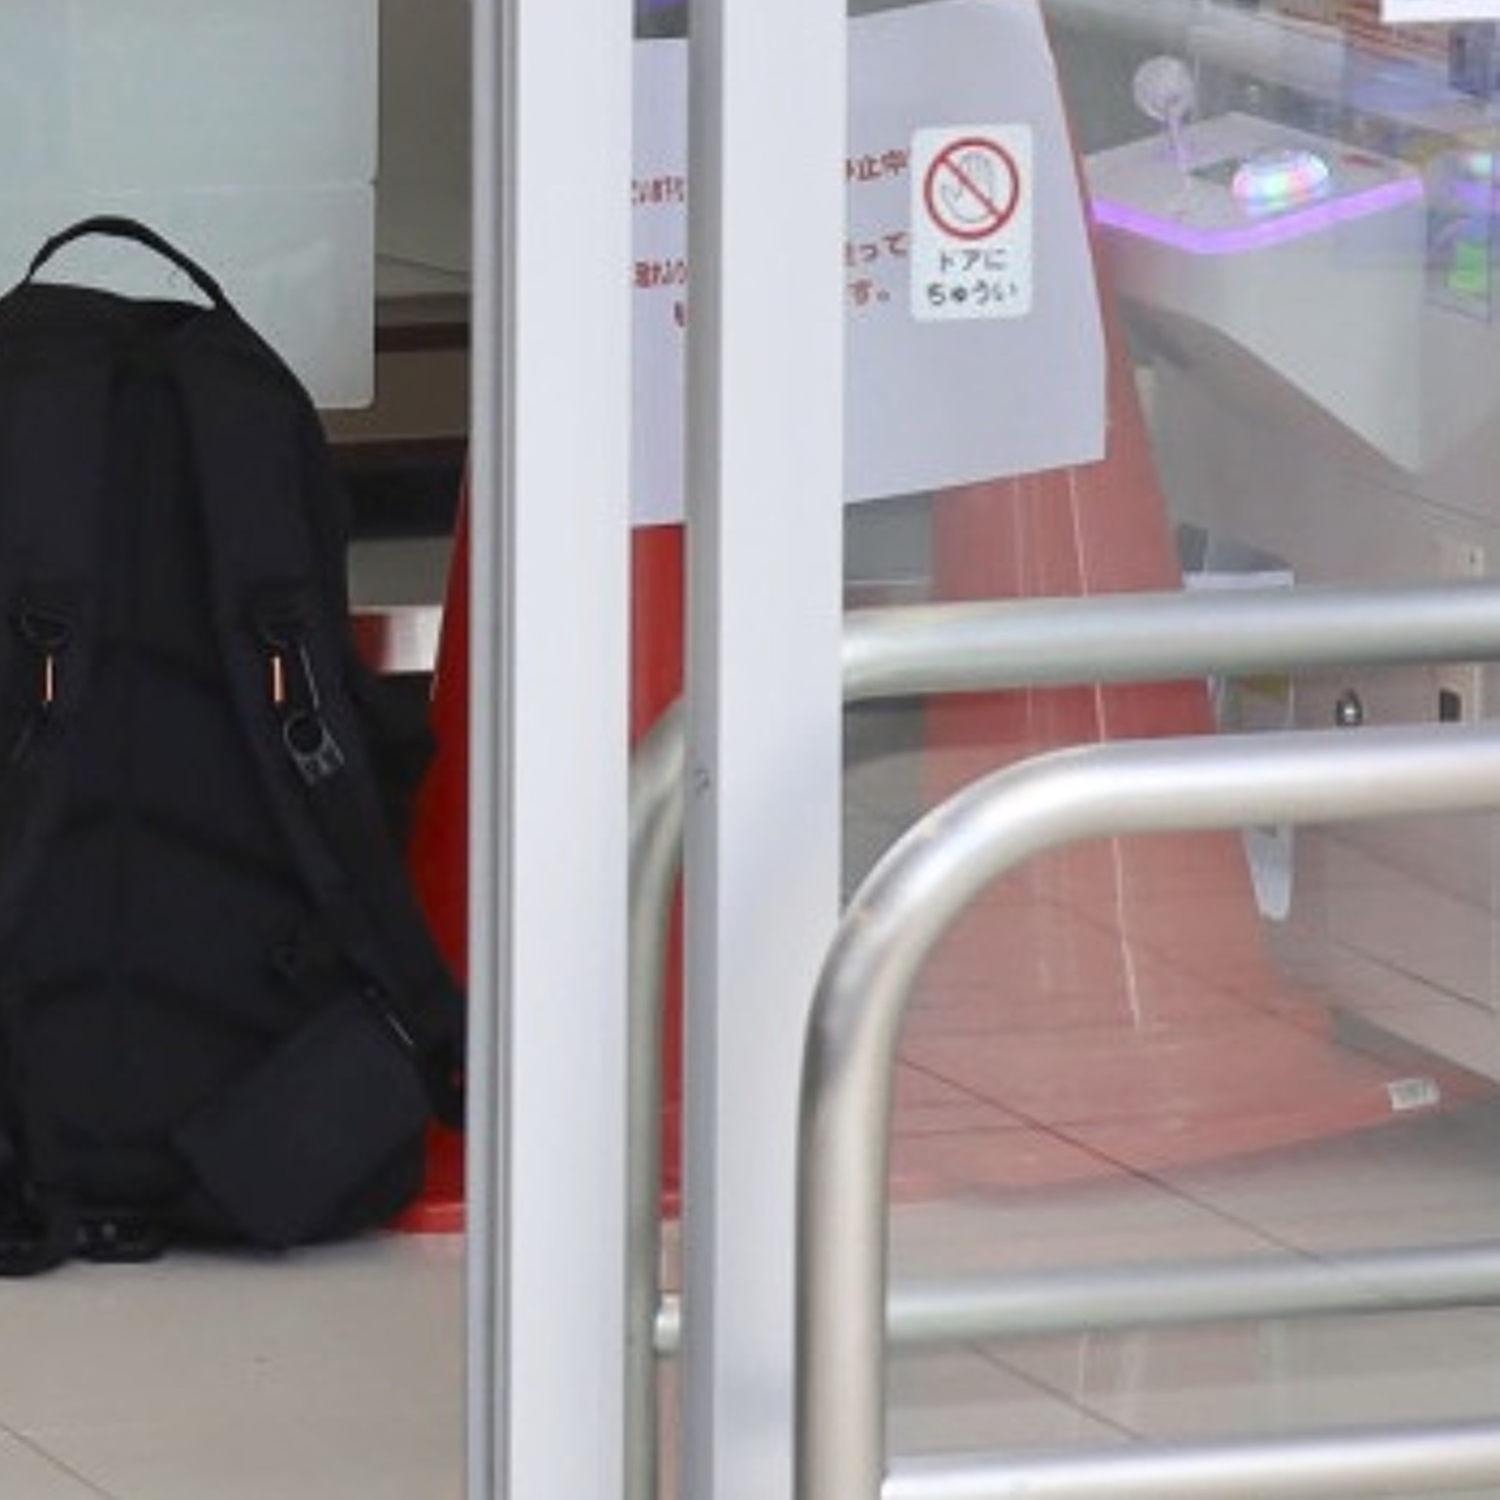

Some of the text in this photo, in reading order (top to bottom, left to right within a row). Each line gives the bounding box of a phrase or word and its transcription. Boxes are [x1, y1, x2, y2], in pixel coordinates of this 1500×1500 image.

[940, 248, 1006, 272] ドアに
[927, 279, 1018, 306] ちゅうい
